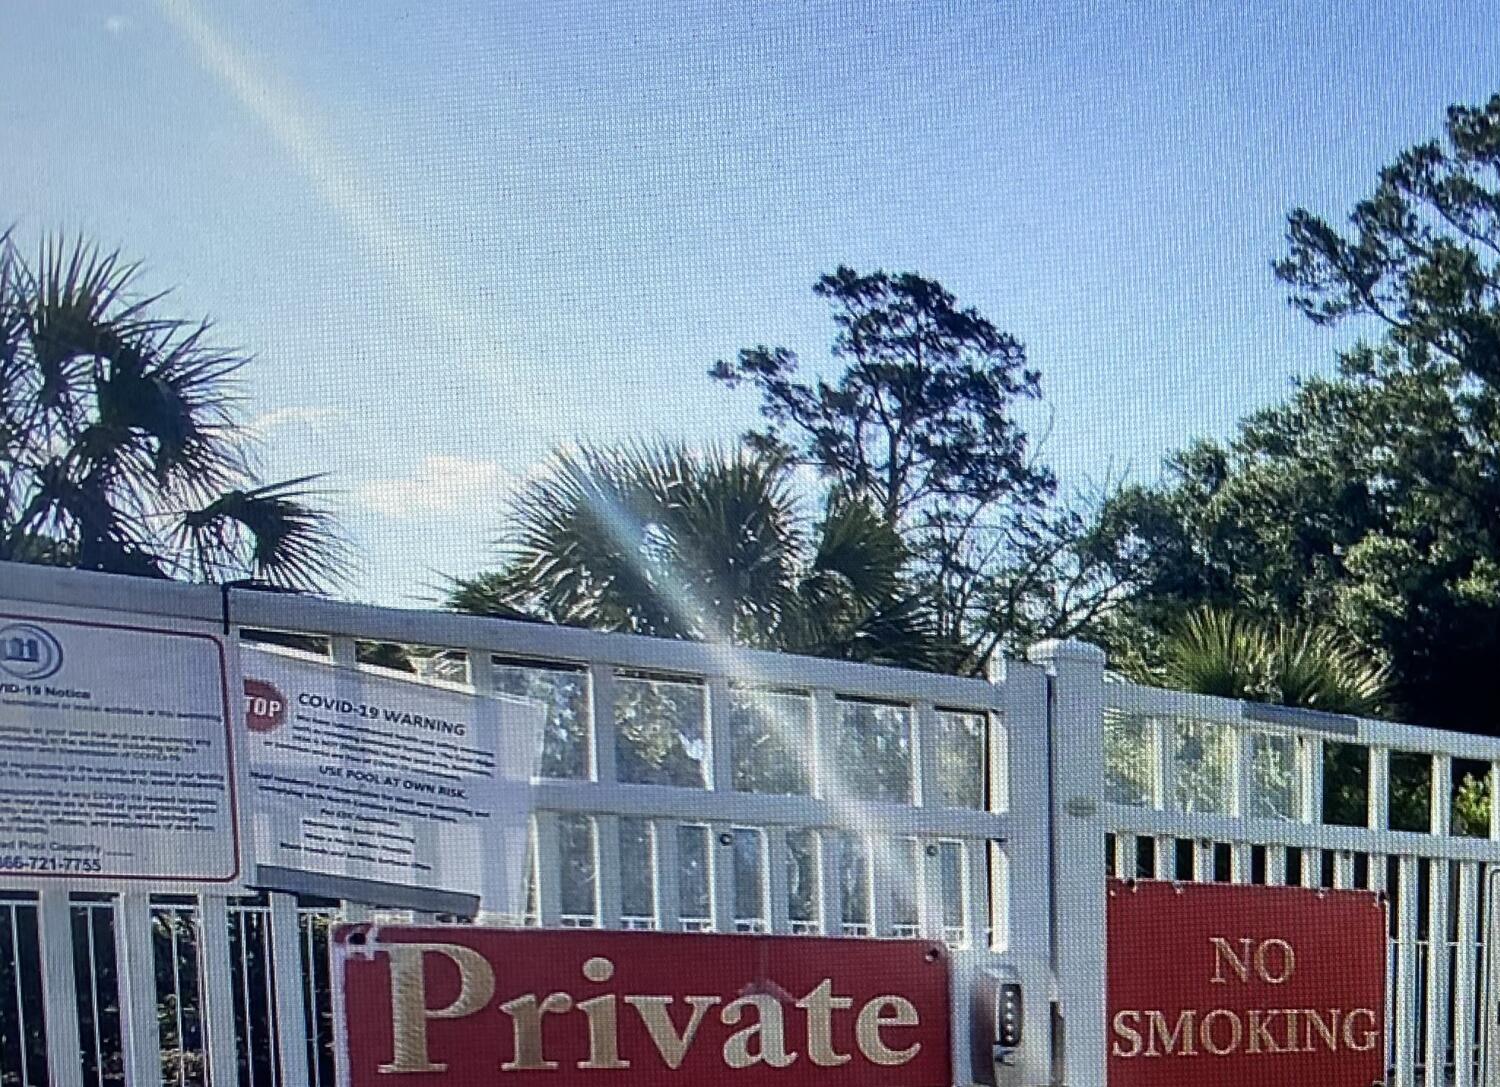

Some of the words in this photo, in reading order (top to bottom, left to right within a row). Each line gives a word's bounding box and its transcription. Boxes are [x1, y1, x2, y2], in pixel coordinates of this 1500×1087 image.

[44, 684, 91, 699] Notice
[299, 692, 378, 720] COVID-19
[383, 708, 467, 736] WARNING
[319, 765, 344, 778] USE
[346, 769, 380, 785] POOL
[384, 776, 402, 788] AT
[403, 780, 435, 794] OWN
[1209, 936, 1296, 984] NO
[377, 940, 922, 1073] Private
[1111, 1007, 1378, 1058] SMOKING
